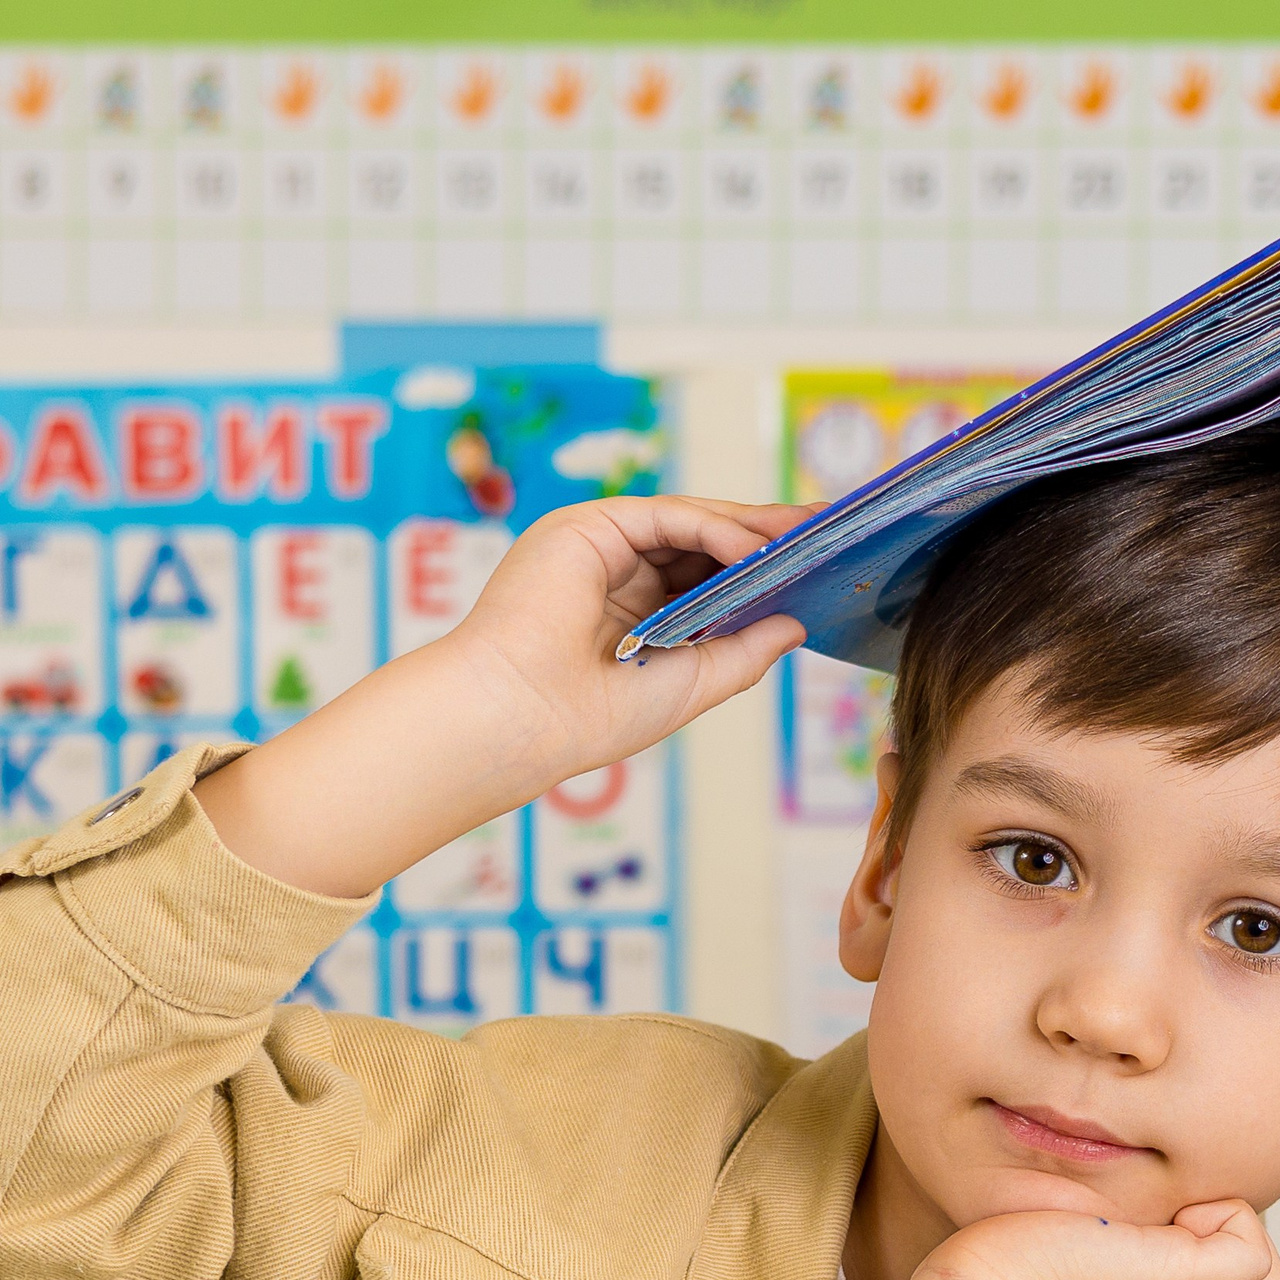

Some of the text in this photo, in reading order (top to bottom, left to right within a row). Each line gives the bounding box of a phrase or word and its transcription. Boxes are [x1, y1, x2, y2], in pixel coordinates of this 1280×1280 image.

[0, 405, 386, 502] АВИТ
[129, 534, 213, 620] Д
[404, 932, 477, 1015] Ц
[544, 930, 608, 1010] Ч
